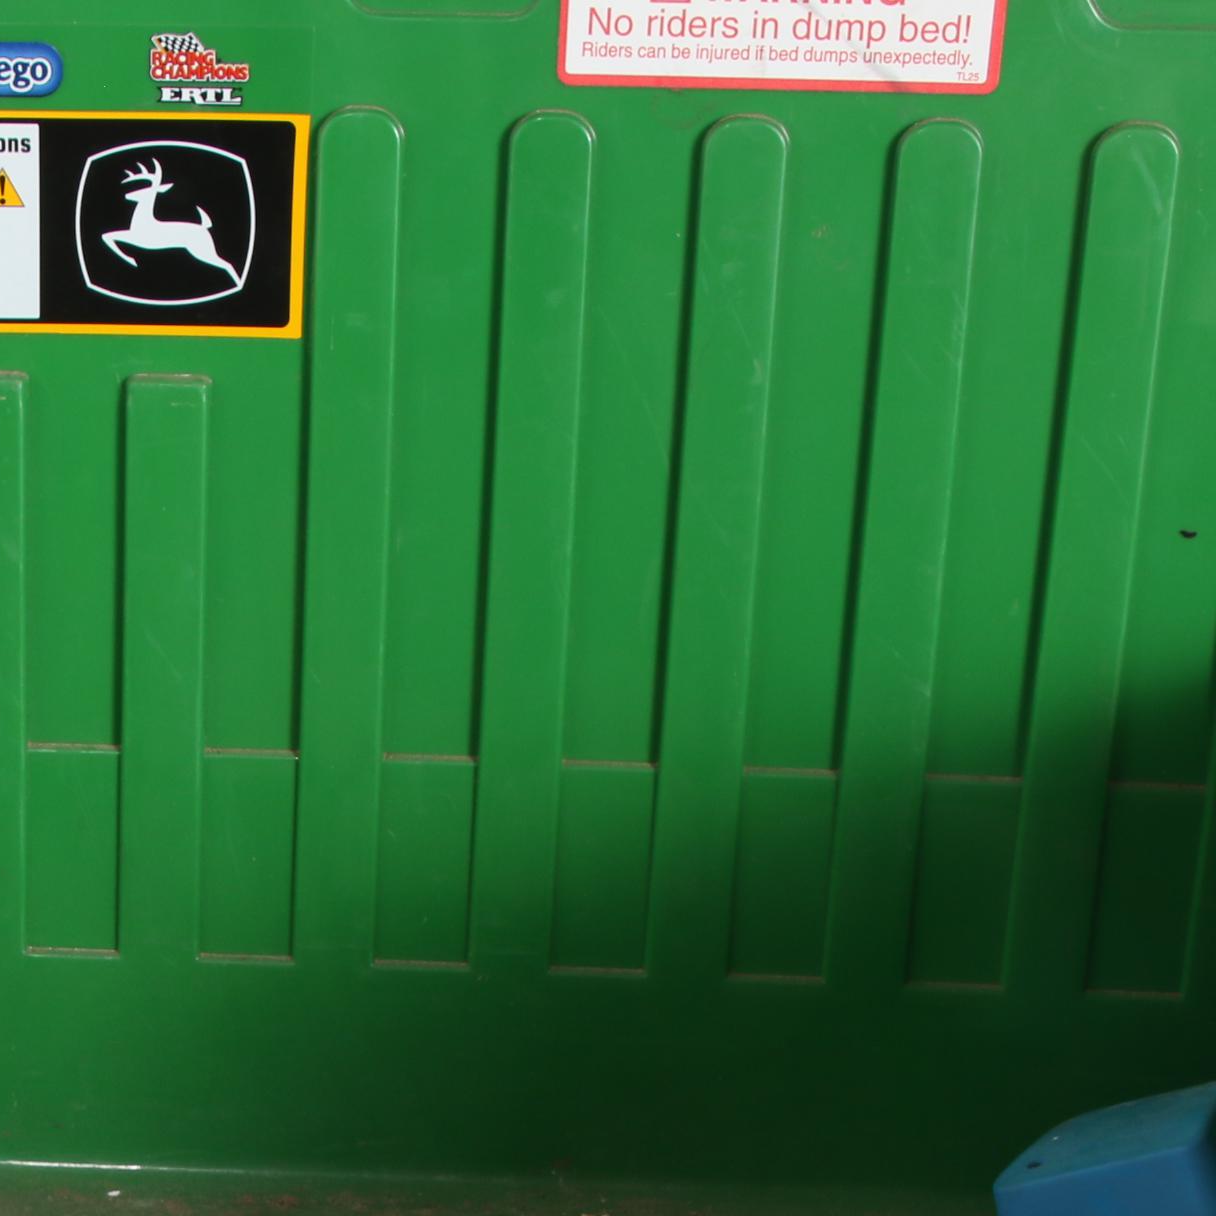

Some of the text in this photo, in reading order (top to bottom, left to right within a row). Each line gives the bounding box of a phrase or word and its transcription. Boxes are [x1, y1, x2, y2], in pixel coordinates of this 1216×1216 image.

[588, 8, 972, 49] No riders in dump bed!
[151, 50, 215, 65] RACING
[581, 42, 974, 70] Riders can be injured if bed dumps unexpectedly.
[151, 64, 248, 80] CHAMPIONS
[957, 72, 980, 82] TL25
[160, 87, 242, 105] ERTL
